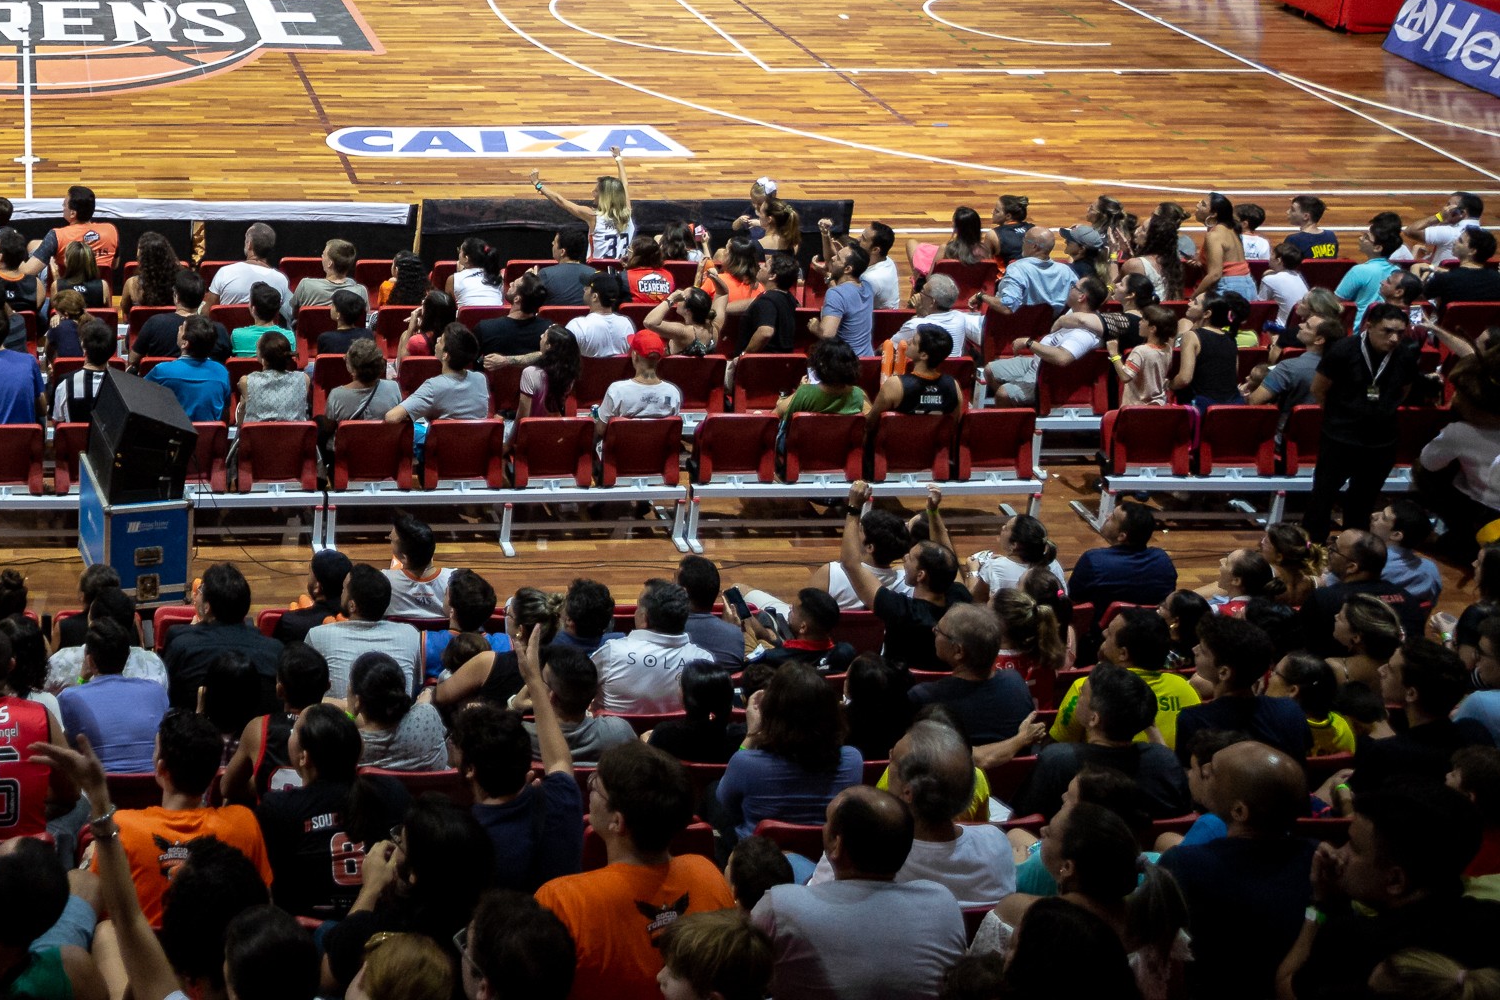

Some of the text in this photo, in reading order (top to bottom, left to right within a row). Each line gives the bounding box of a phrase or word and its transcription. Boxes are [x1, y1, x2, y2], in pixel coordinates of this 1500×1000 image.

[1423, 3, 1500, 77] He
[338, 129, 673, 153] CAIXA
[1311, 243, 1335, 258] JAMES
[638, 280, 670, 294] CEARENSE
[627, 651, 687, 671] SOLA
